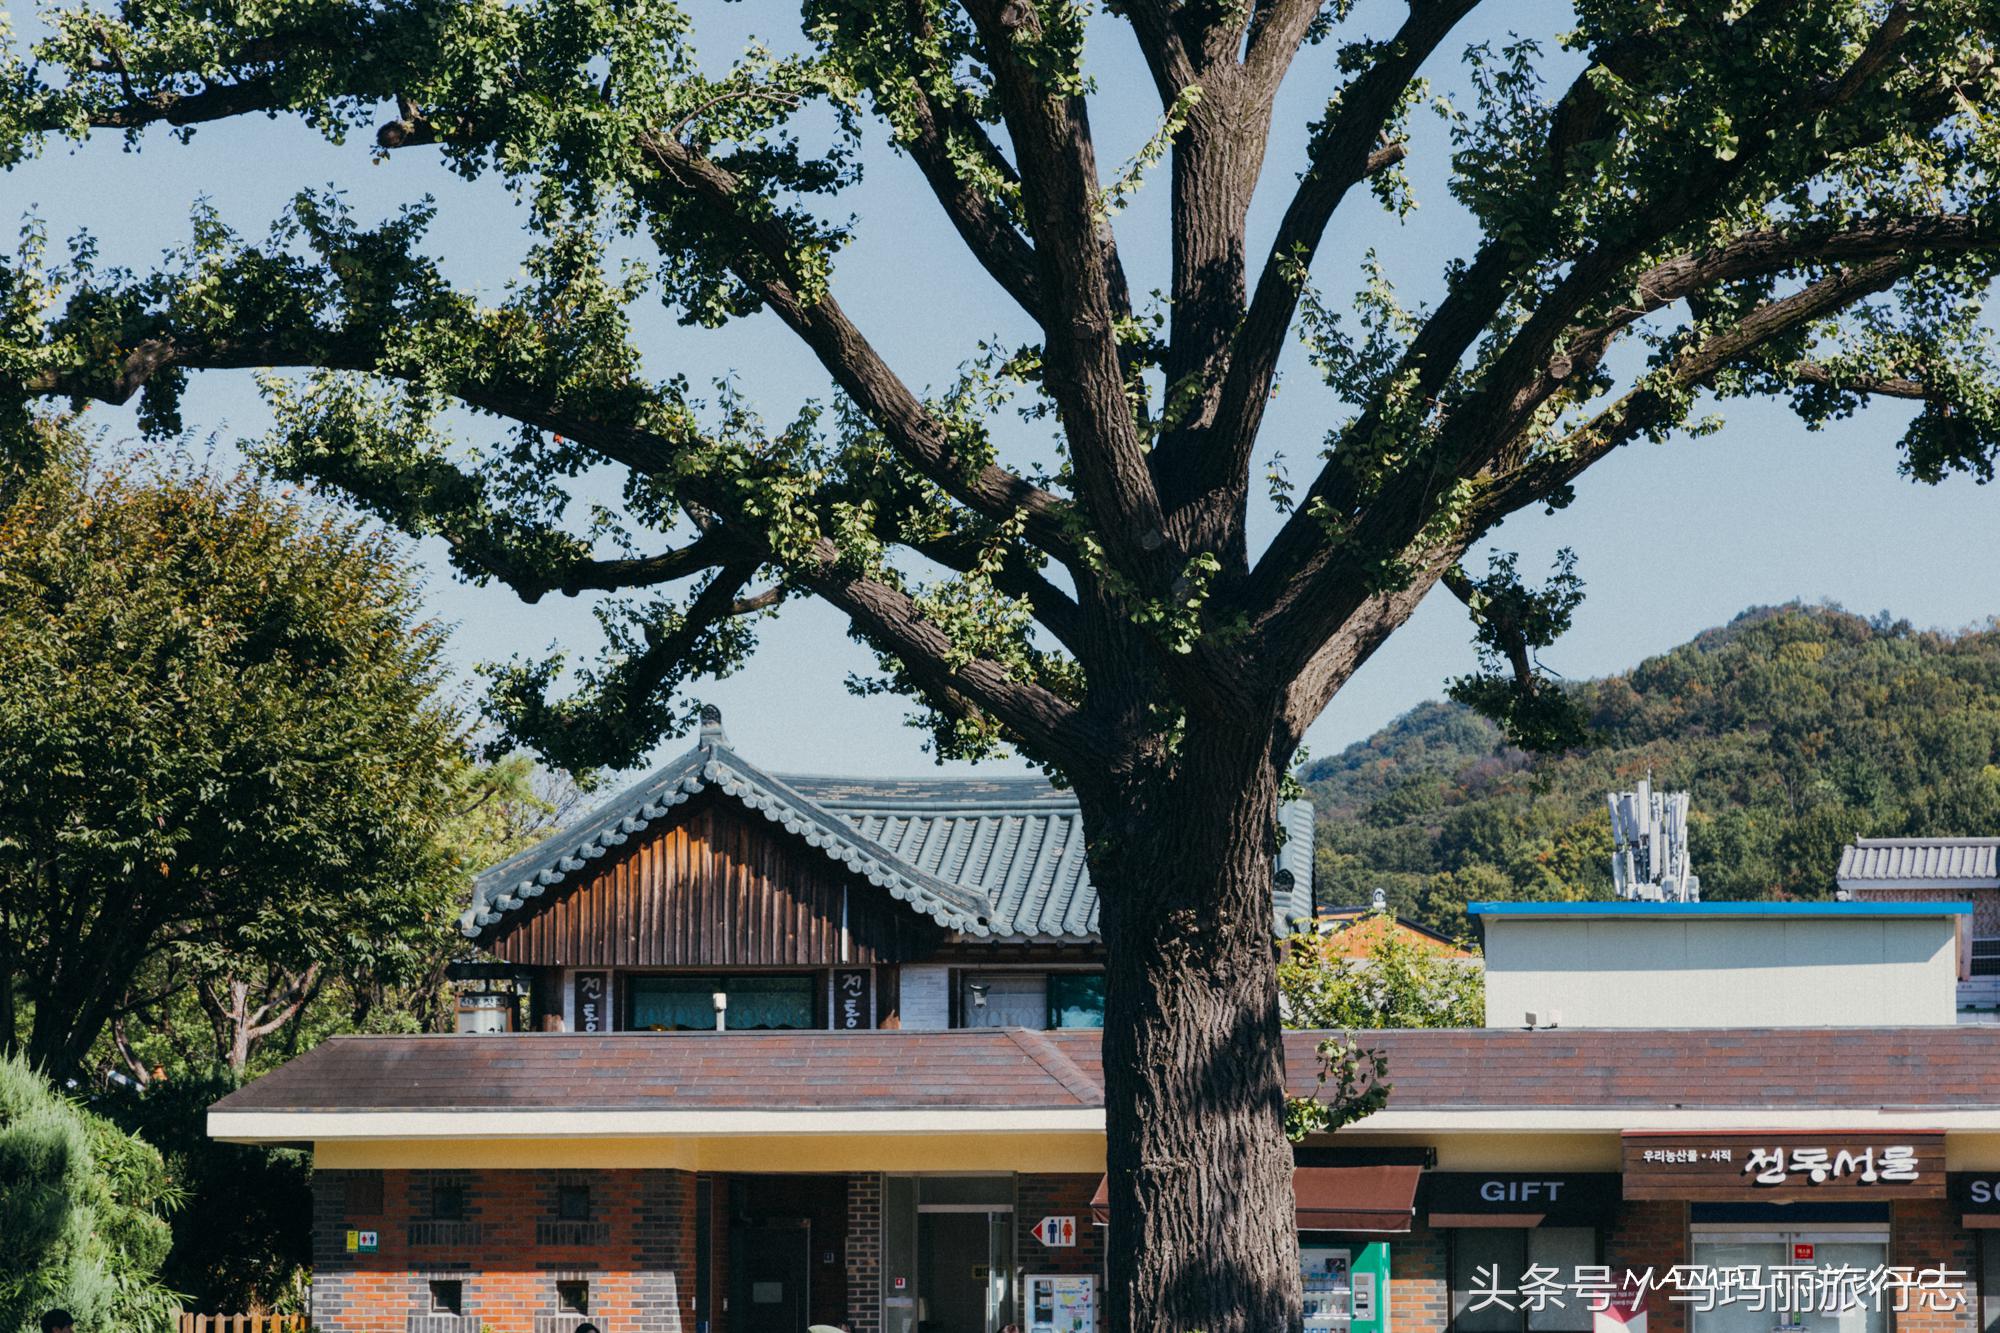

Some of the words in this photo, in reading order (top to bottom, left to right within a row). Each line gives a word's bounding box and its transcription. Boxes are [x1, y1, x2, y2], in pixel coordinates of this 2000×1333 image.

[1643, 1149, 1698, 1163] 우리농산물
[1480, 1181, 1565, 1202] GIFT
[1970, 1180, 2000, 1203] S
